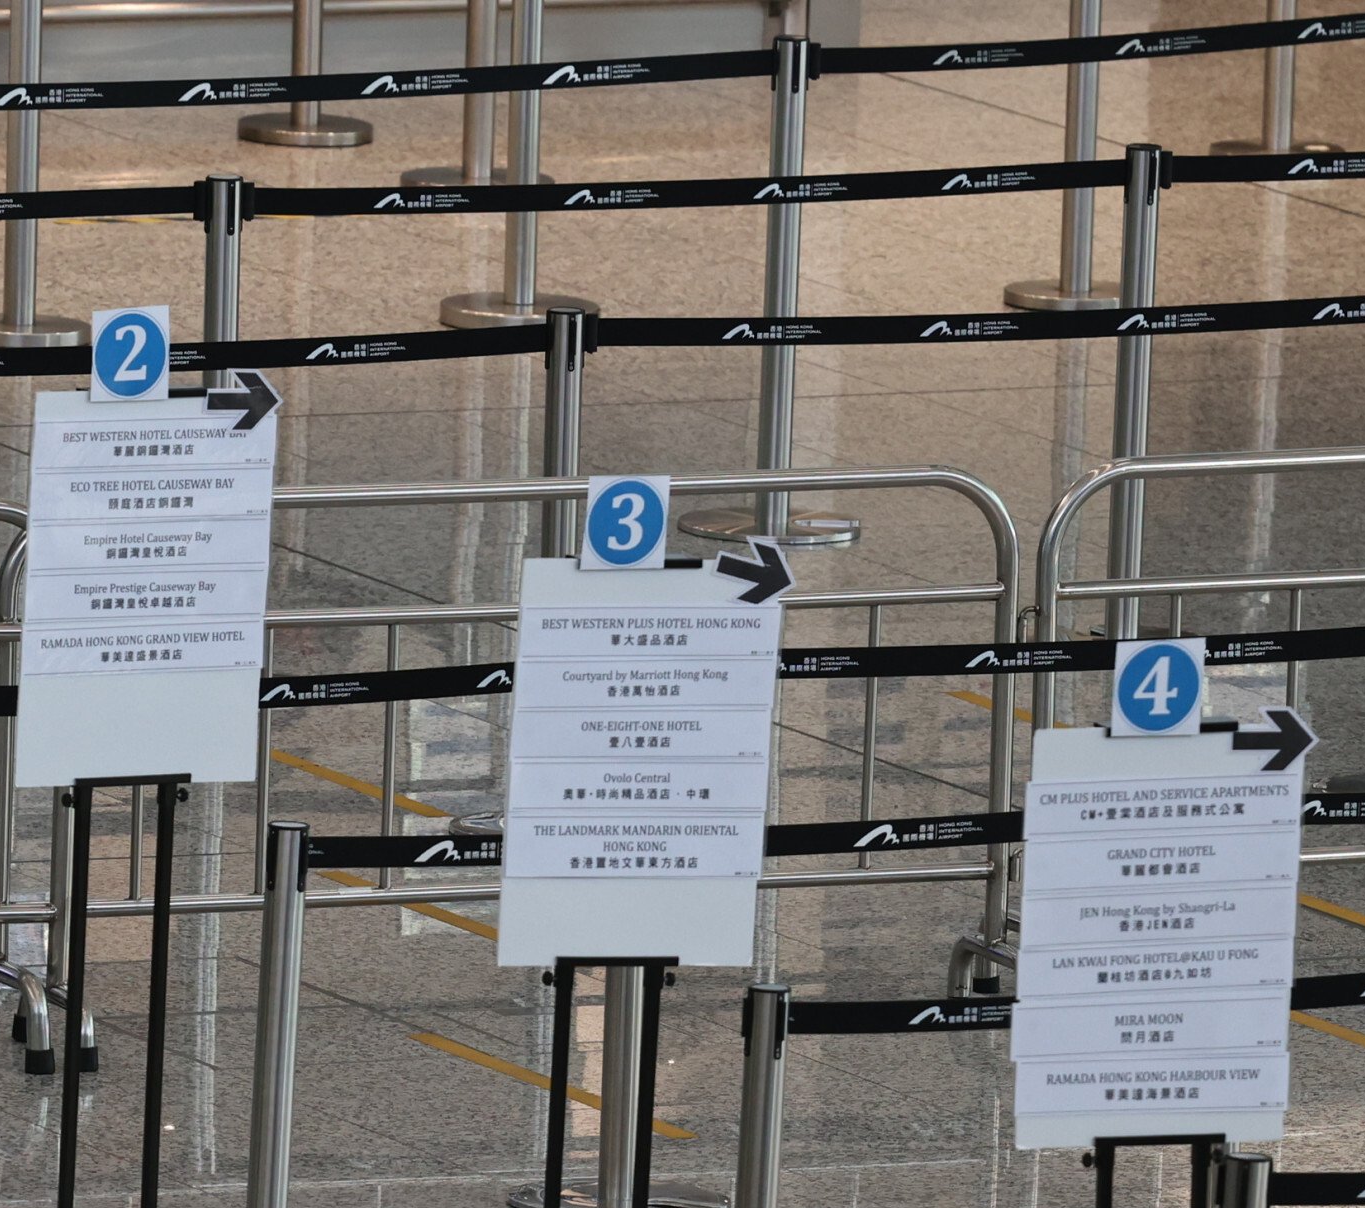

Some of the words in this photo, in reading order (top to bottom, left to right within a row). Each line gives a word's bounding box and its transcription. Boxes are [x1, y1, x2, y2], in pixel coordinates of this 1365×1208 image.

[113, 324, 148, 382] 2
[62, 432, 88, 442] BEST
[89, 430, 137, 442] WESTERN
[139, 429, 172, 440] HOTEL
[174, 426, 228, 438] CAUSEWAY
[70, 481, 91, 492] ECO
[92, 480, 119, 492] TREE
[121, 479, 156, 491] HOTEL
[157, 478, 212, 490] CAUSEWAY
[215, 478, 234, 488] BAY
[606, 492, 645, 552] 3
[83, 534, 118, 547] Empire
[119, 532, 145, 547] Hotel
[146, 532, 193, 547] Causeway
[194, 531, 212, 543] Bay
[74, 584, 108, 596] Empire
[109, 582, 147, 595] Prestige
[149, 582, 196, 594] Causeway
[198, 580, 216, 593] Bay
[541, 618, 570, 629] BEST
[571, 618, 624, 629] WESTERN
[627, 617, 654, 629] PLUS
[656, 618, 694, 628] HOTEL
[696, 618, 728, 628] HONG
[730, 618, 761, 628] KONG
[40, 637, 83, 649] RAMADA
[85, 636, 114, 647] HONG
[116, 634, 143, 645] KONG
[145, 633, 181, 644] GRAND
[182, 632, 210, 642] VIEW
[211, 630, 245, 642] HOTEL
[562, 670, 613, 683] Courtyard
[615, 670, 627, 683] by
[629, 670, 671, 680] Marriott
[673, 669, 700, 682] Hong
[702, 668, 729, 682] Kong
[1133, 656, 1179, 717] 4
[581, 720, 664, 731] ONE-EIGHT-ONE
[666, 720, 702, 731] HOTEL
[603, 772, 632, 783] Ovolo
[634, 772, 671, 783] Central
[533, 825, 556, 836] THE
[558, 824, 620, 836] LANDMARK
[622, 824, 681, 836] MANDARIN
[684, 824, 739, 836] ORIENTAL
[603, 840, 634, 852] HONG
[636, 841, 667, 852] KONG
[1107, 848, 1147, 860] GRAND
[1149, 847, 1176, 858] CITY
[1178, 845, 1216, 857] HOTEL
[1114, 1014, 1145, 1026] MIRA
[1147, 1012, 1183, 1025] MOON
[1046, 1072, 1096, 1085] RAMADA
[1099, 1071, 1132, 1083] HONG
[1134, 1070, 1167, 1082] KONG
[1169, 1069, 1227, 1081] HARBOUR
[1228, 1068, 1261, 1080] VIEW
